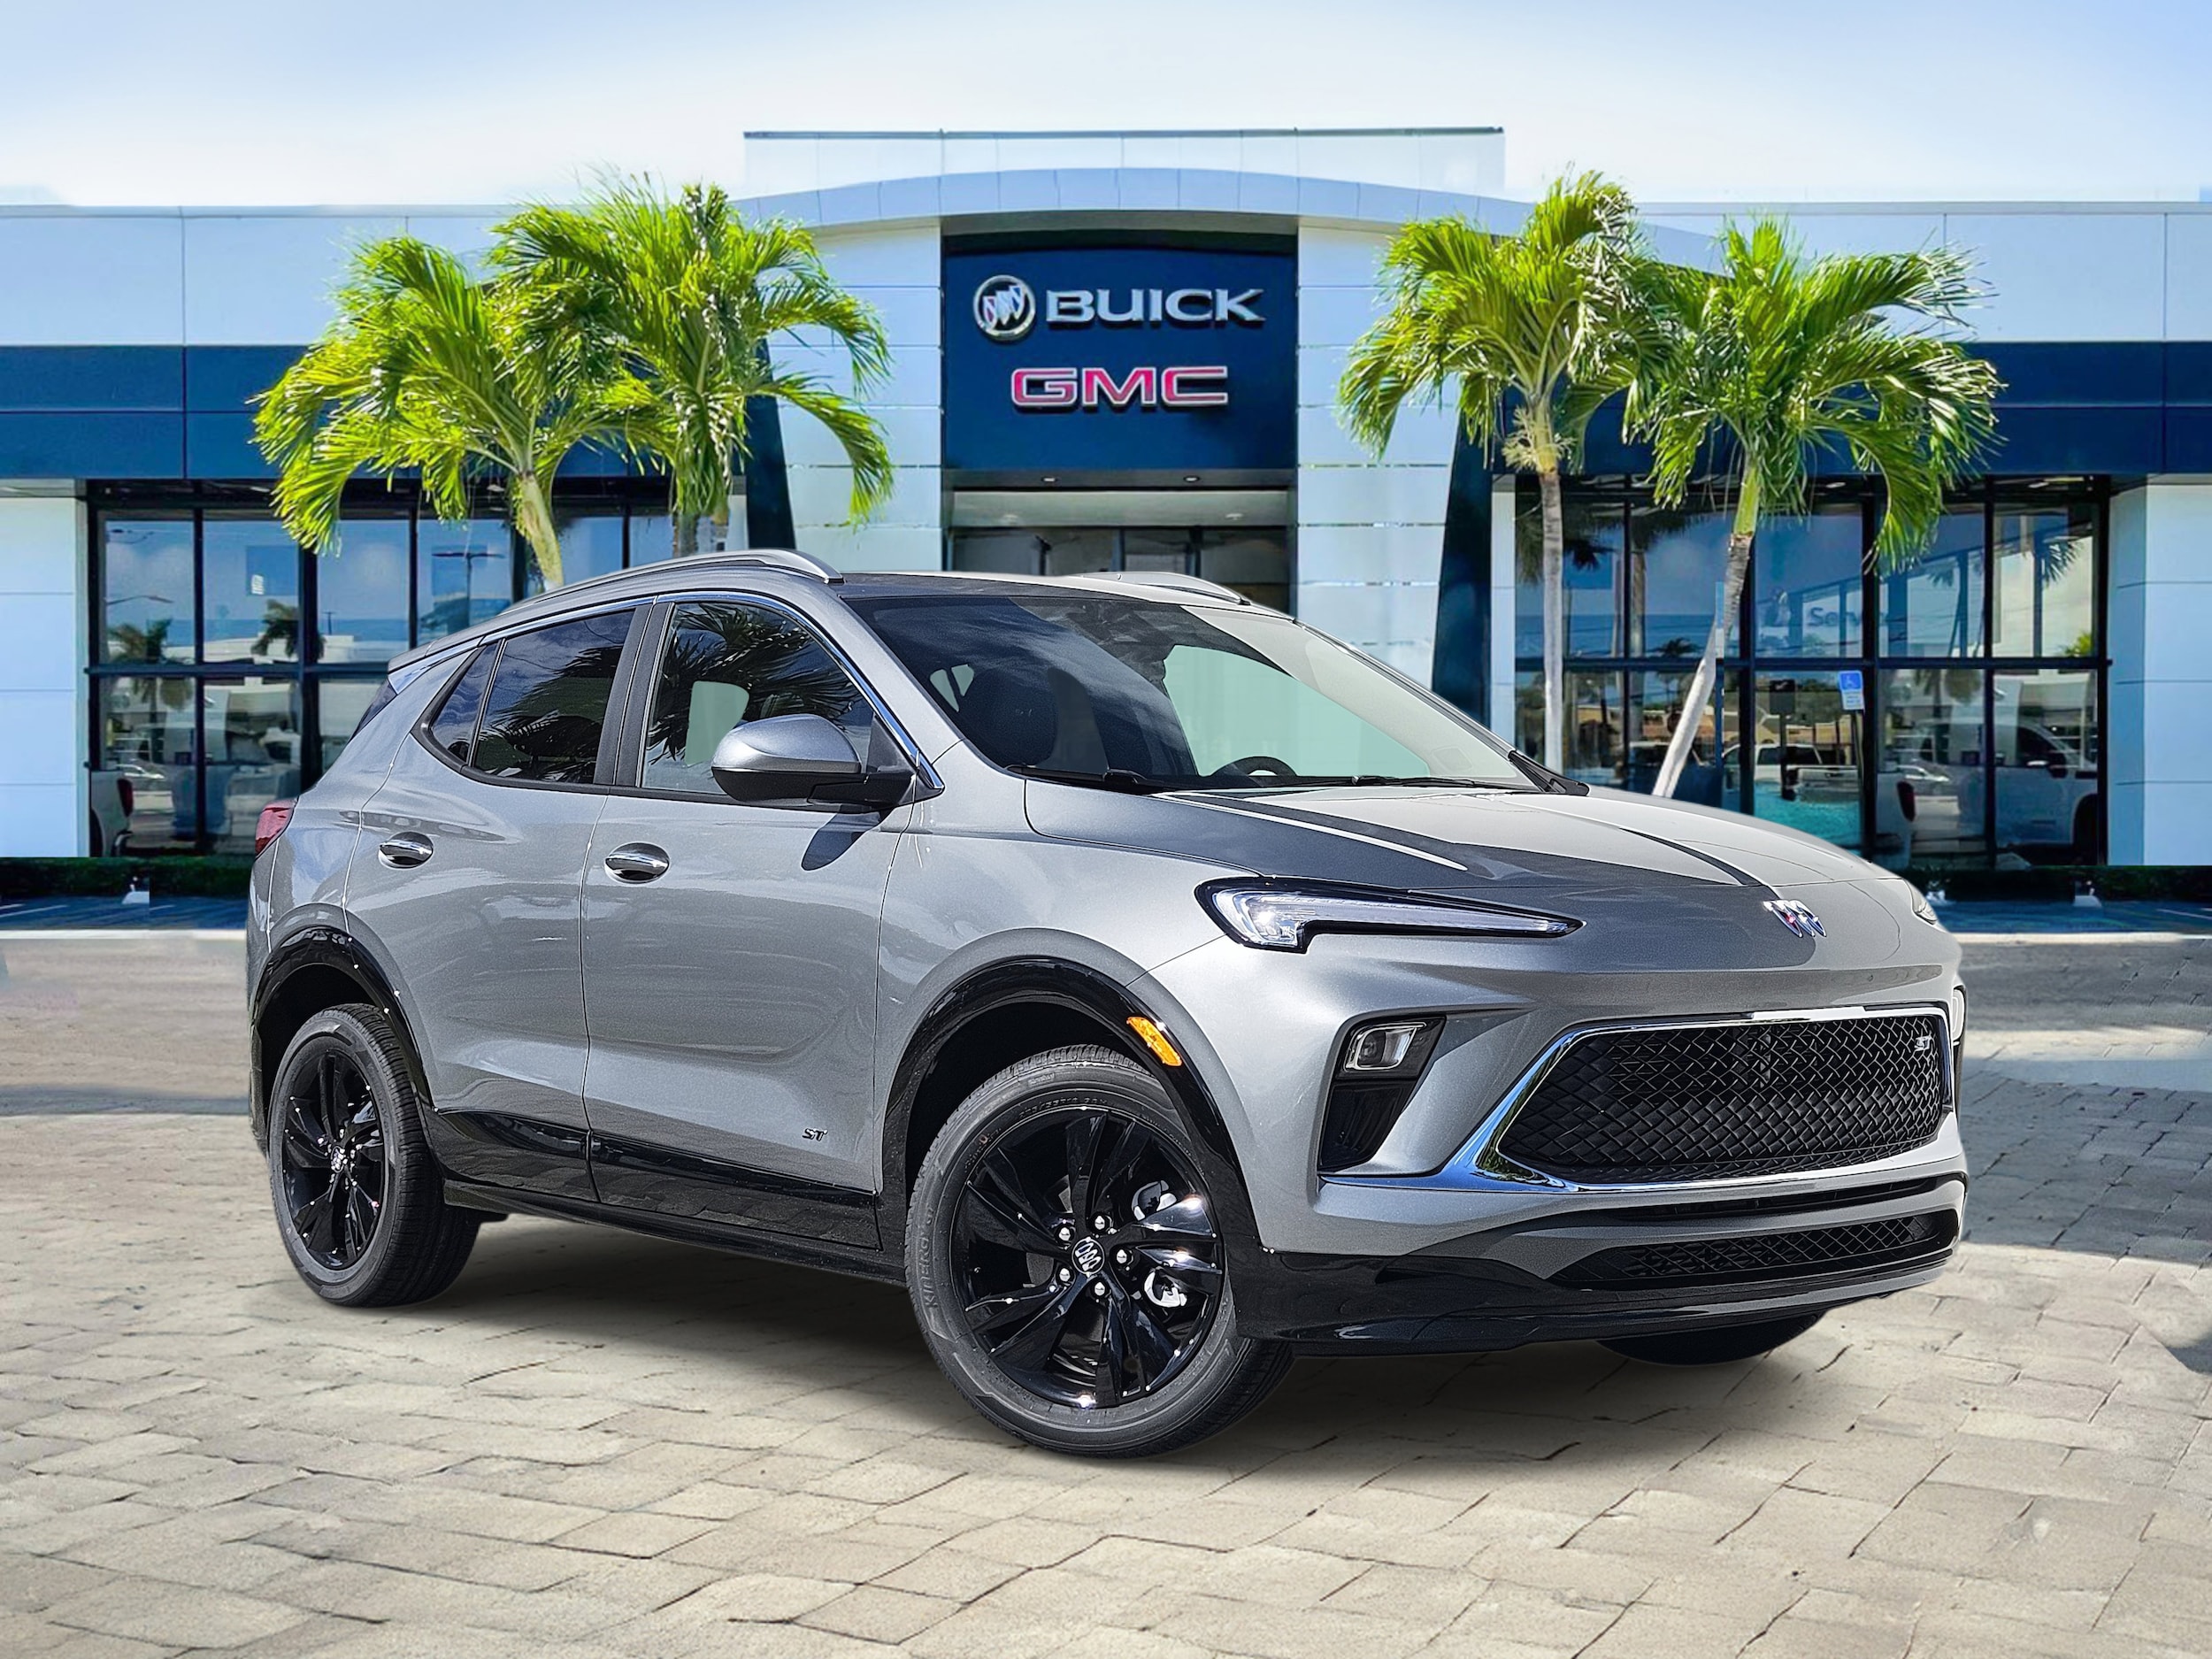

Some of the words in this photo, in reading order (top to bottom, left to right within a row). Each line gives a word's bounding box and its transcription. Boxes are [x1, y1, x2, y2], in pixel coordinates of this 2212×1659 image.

[1046, 288, 1265, 322] BUICK
[1011, 365, 1228, 408] GMC
[802, 1128, 828, 1142] ST
